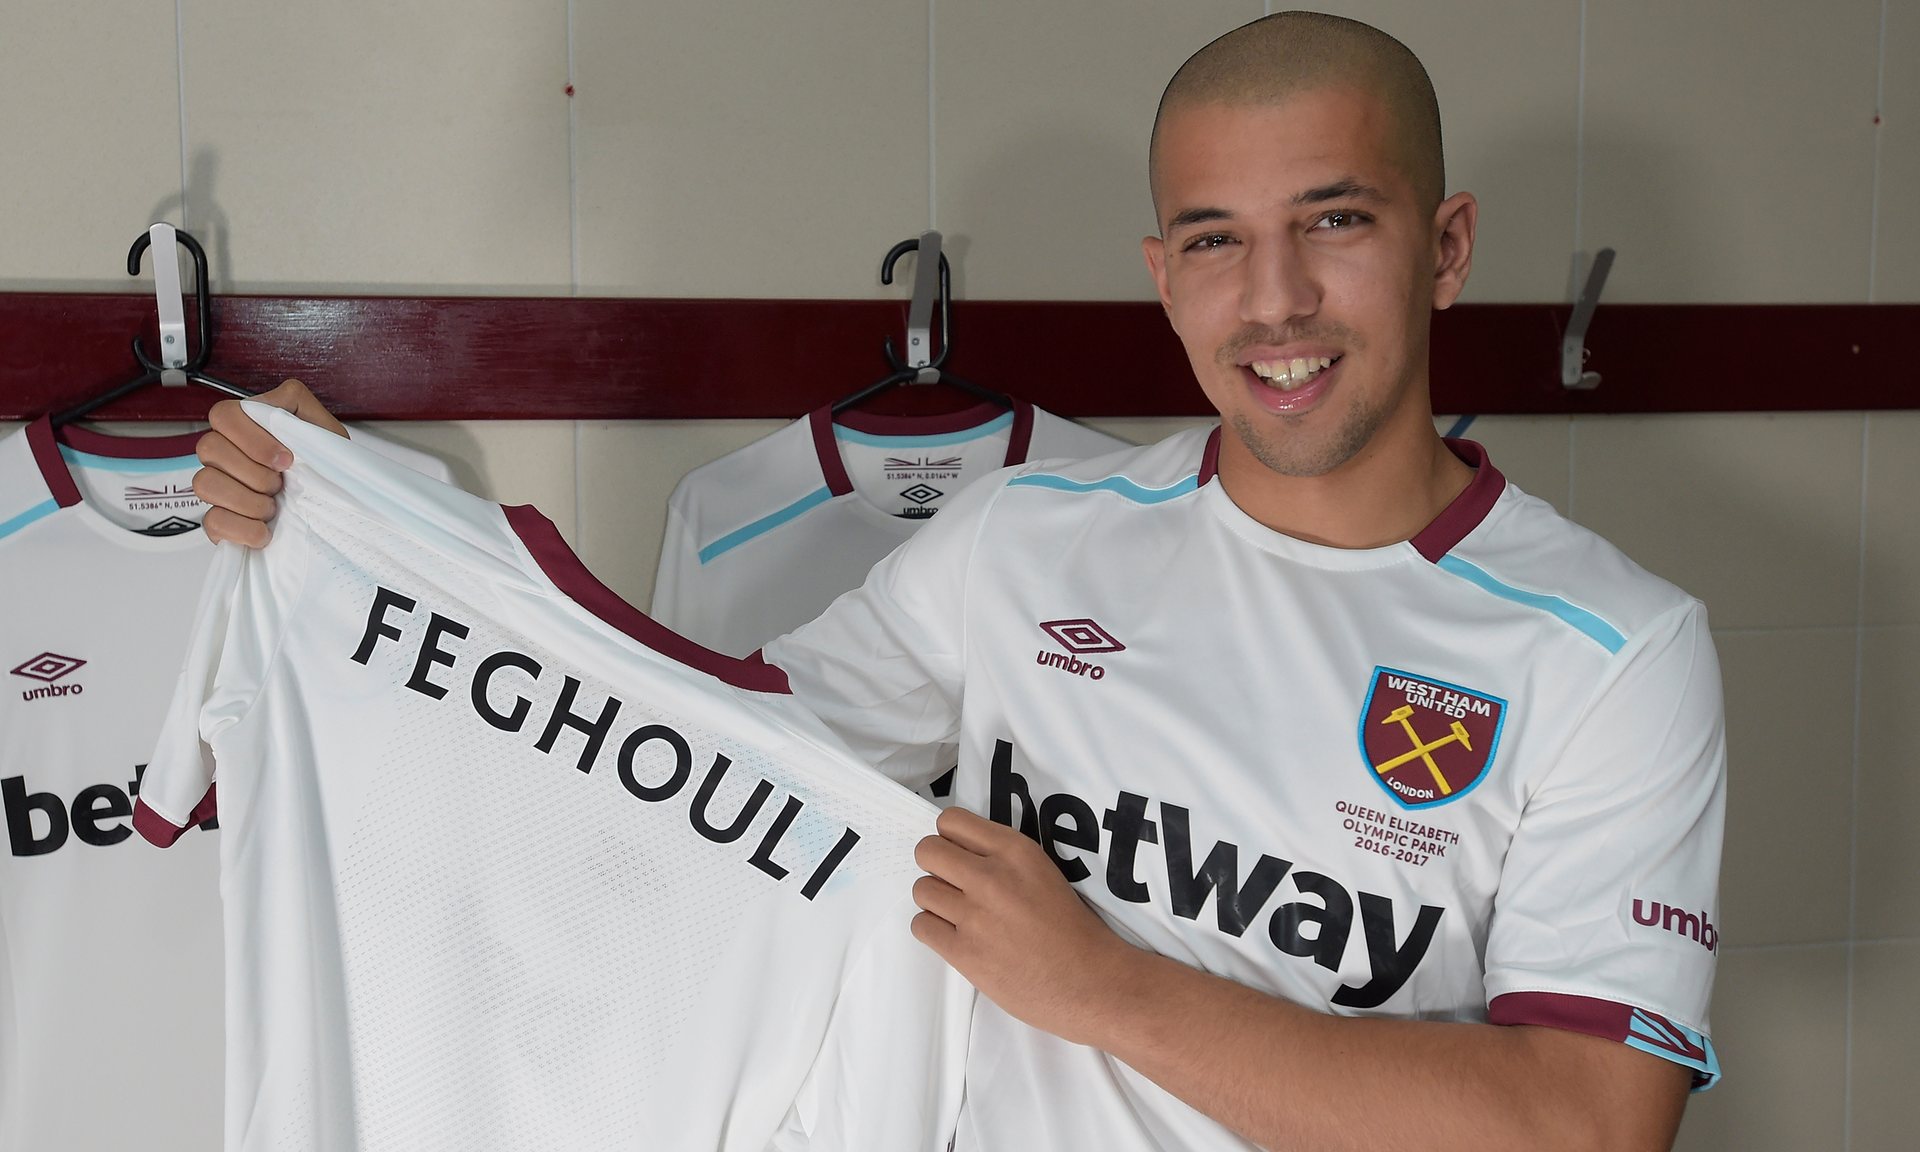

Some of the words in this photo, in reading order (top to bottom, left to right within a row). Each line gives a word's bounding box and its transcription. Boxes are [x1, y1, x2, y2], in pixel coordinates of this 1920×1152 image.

[1036, 650, 1105, 680] umbro
[22, 683, 83, 701] umbro
[1388, 675, 1441, 699] WEST
[1443, 691, 1490, 717] HAM
[1406, 692, 1466, 719] UNITED
[350, 586, 861, 901] FEGHOULI
[1387, 776, 1434, 799] LONDON
[1335, 800, 1386, 825] QUEEN
[1389, 816, 1459, 845] ELIZABETH
[1343, 818, 1408, 847] OLYMPIC
[1411, 838, 1446, 857] PARK
[1354, 836, 1429, 867] 2016-2017
[990, 738, 1445, 1009] betway
